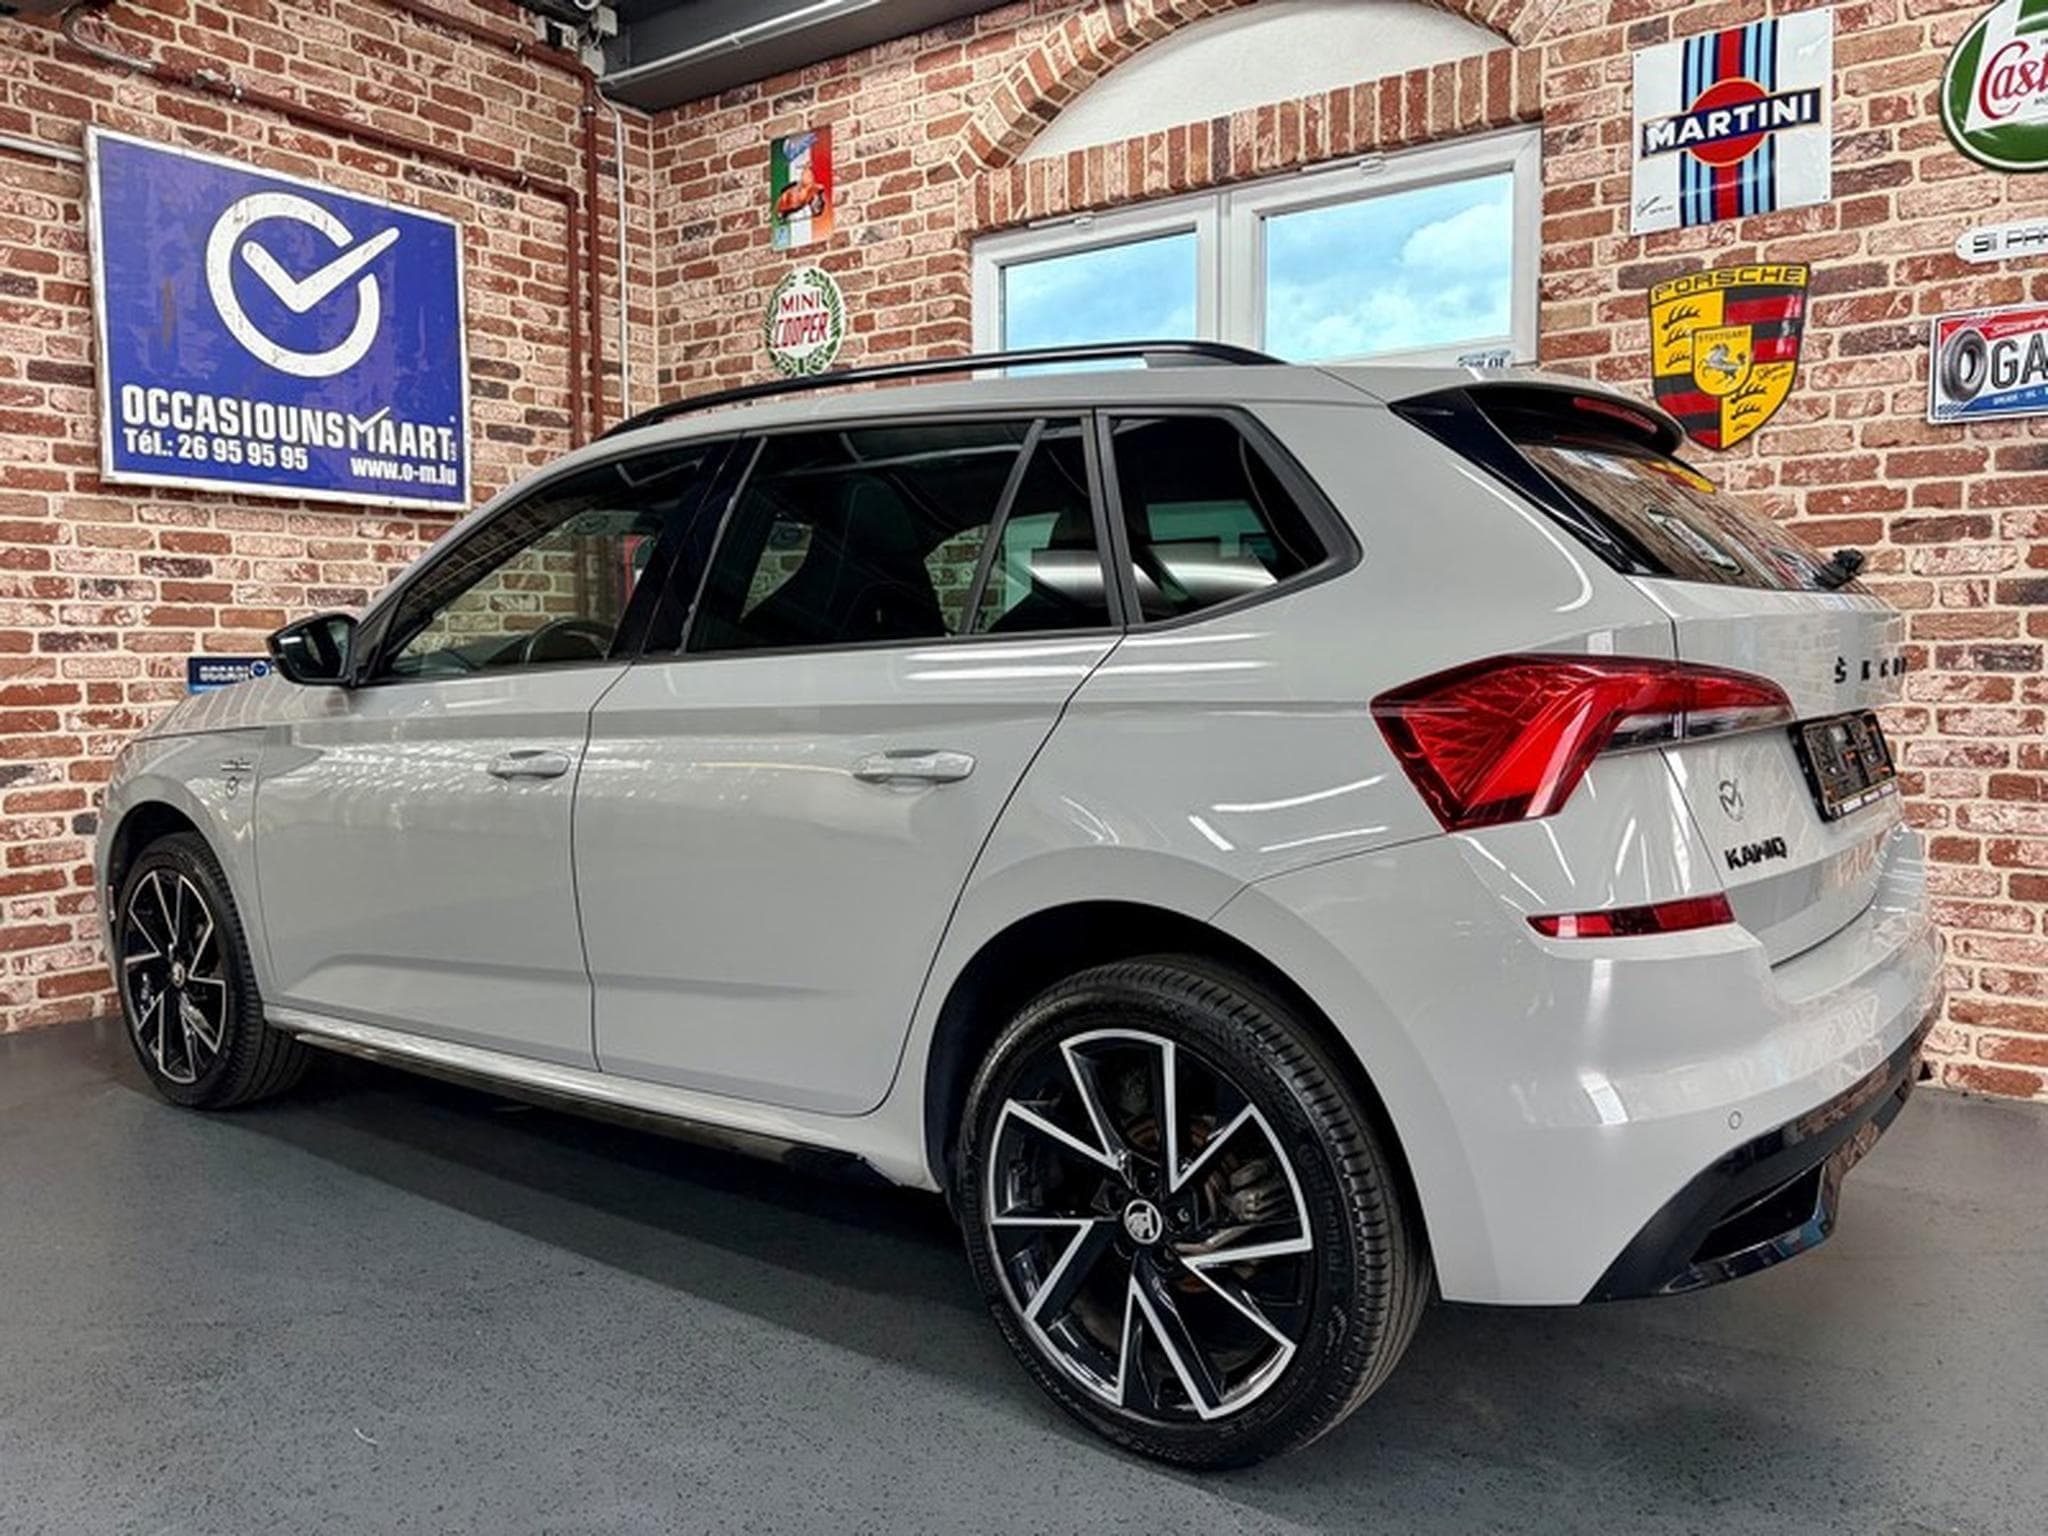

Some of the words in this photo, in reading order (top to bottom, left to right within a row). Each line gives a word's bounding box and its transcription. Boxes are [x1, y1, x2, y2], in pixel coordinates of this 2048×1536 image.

[1646, 94, 1812, 151] MARTINI
[1654, 268, 1801, 300] PORSCHE
[781, 291, 820, 313] MINI
[774, 312, 829, 348] COOPER
[123, 427, 172, 457] Tél.:
[178, 434, 208, 460] 26
[213, 439, 242, 464] 95
[248, 443, 275, 468] 95
[280, 446, 308, 471] 95
[351, 457, 457, 486] www.o-m.lu
